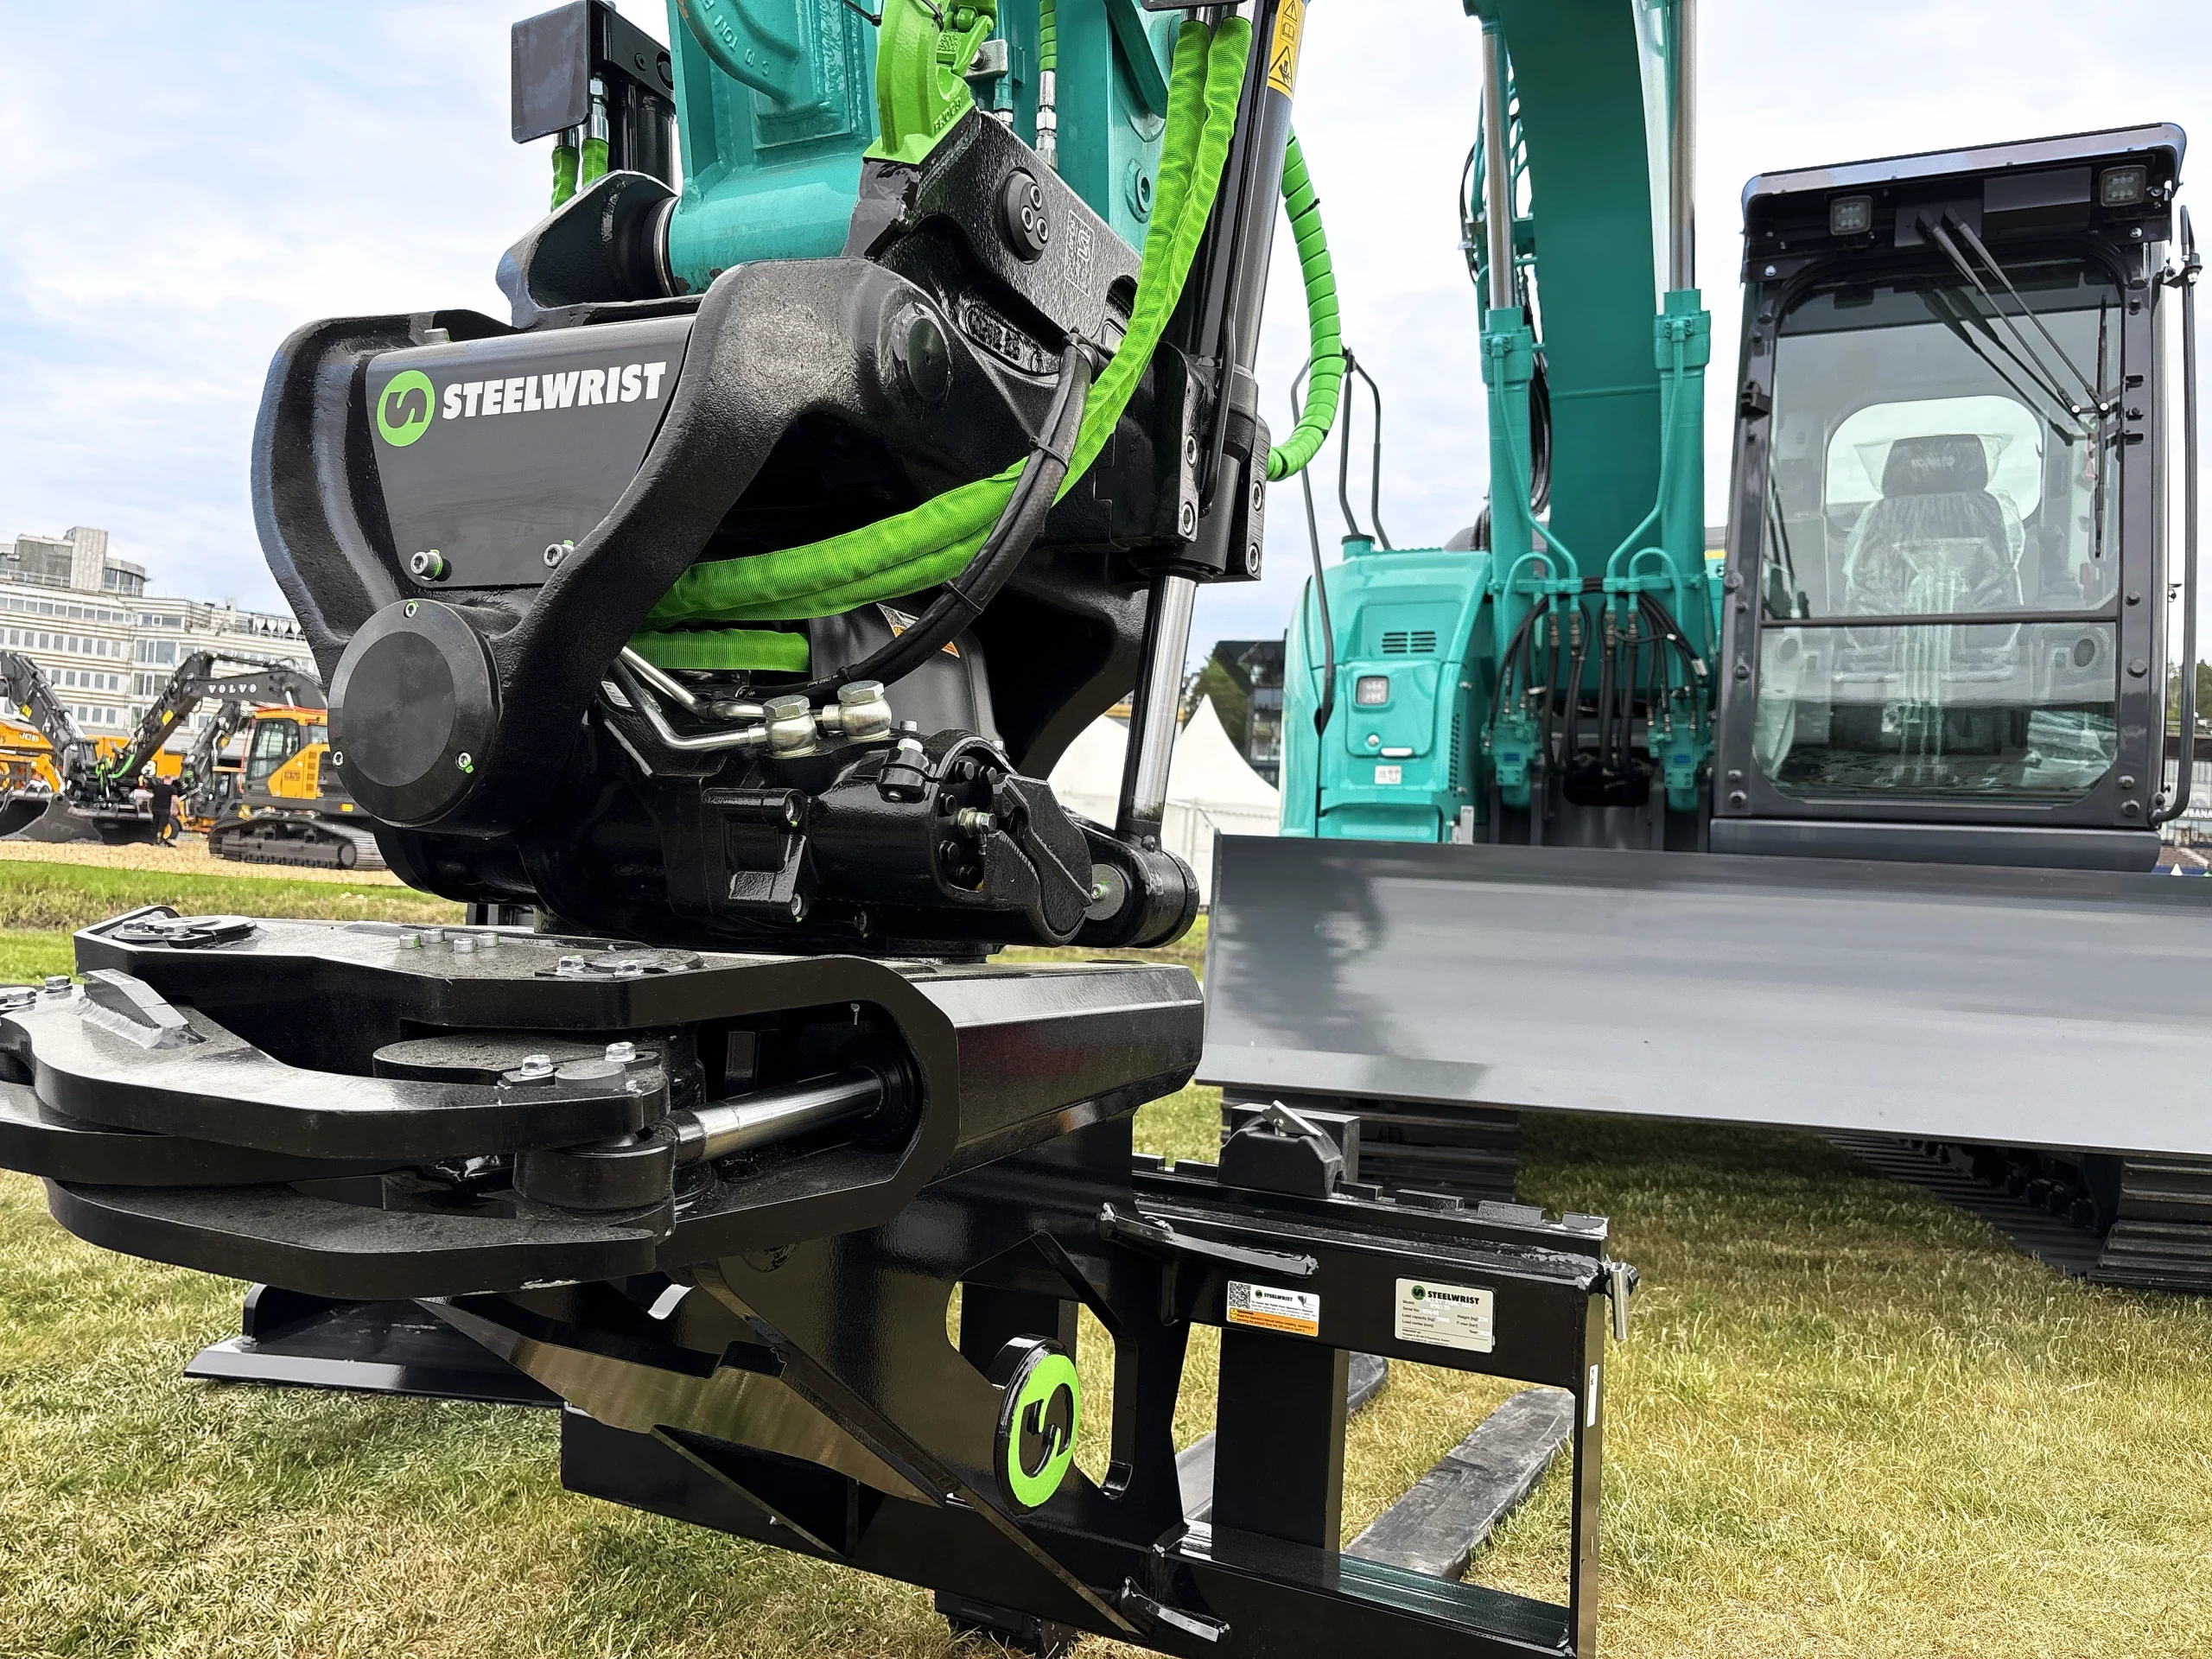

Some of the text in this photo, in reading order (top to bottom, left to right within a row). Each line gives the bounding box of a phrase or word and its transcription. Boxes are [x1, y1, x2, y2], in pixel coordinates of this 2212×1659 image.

[442, 361, 667, 420] STEELWRIST
[208, 684, 257, 694] VOLVO
[1263, 1292, 1294, 1302] STEELWRIST
[1427, 1291, 1479, 1305] STEELWRIST
